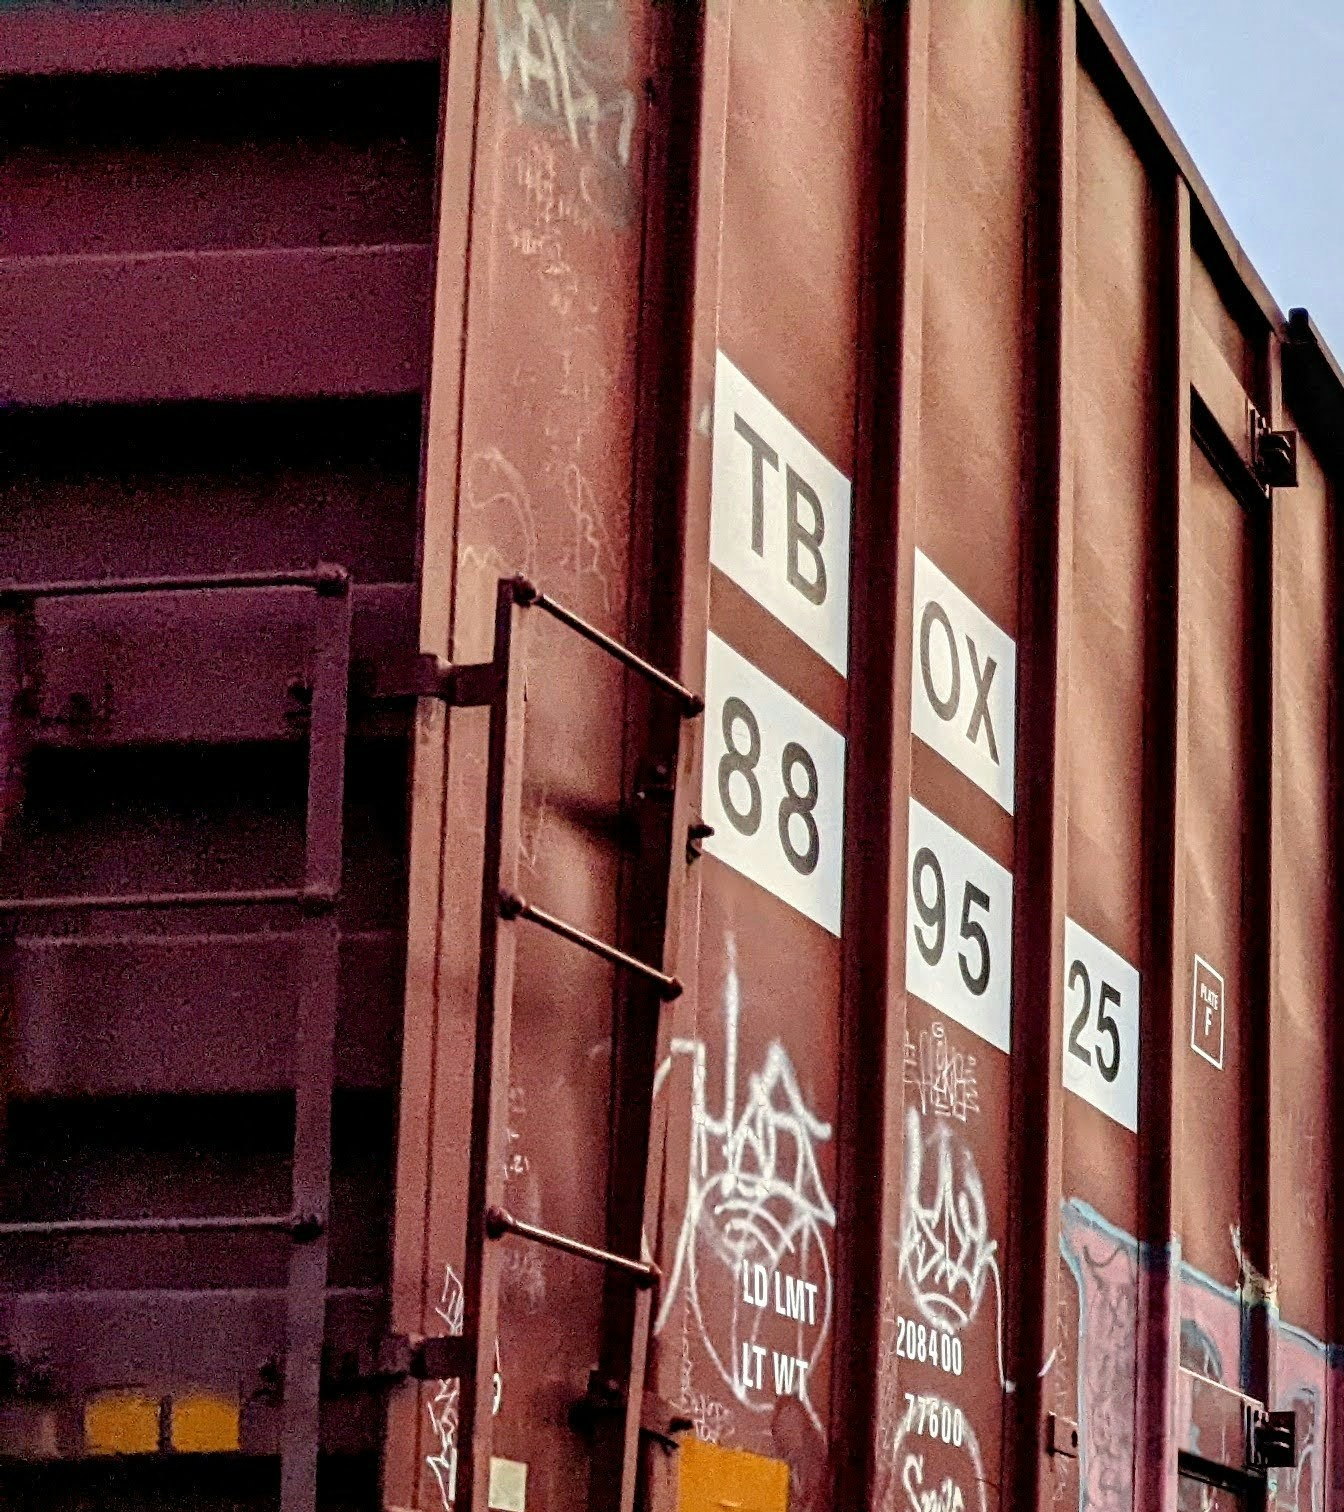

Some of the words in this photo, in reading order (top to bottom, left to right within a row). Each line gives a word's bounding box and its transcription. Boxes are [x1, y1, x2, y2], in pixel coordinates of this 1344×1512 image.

[734, 411, 828, 607] TB
[920, 601, 1000, 767] OX
[717, 696, 820, 876] 88
[912, 847, 991, 997] 95
[1069, 960, 1122, 1083] 25
[1200, 982, 1219, 1011] PLATE
[1205, 1006, 1213, 1036] F
[743, 1259, 768, 1308] LD
[775, 1270, 818, 1325] LMT
[896, 1316, 962, 1376] 208400
[742, 1342, 767, 1390] LT
[772, 1352, 809, 1402] WT
[904, 1392, 962, 1448] 77600
